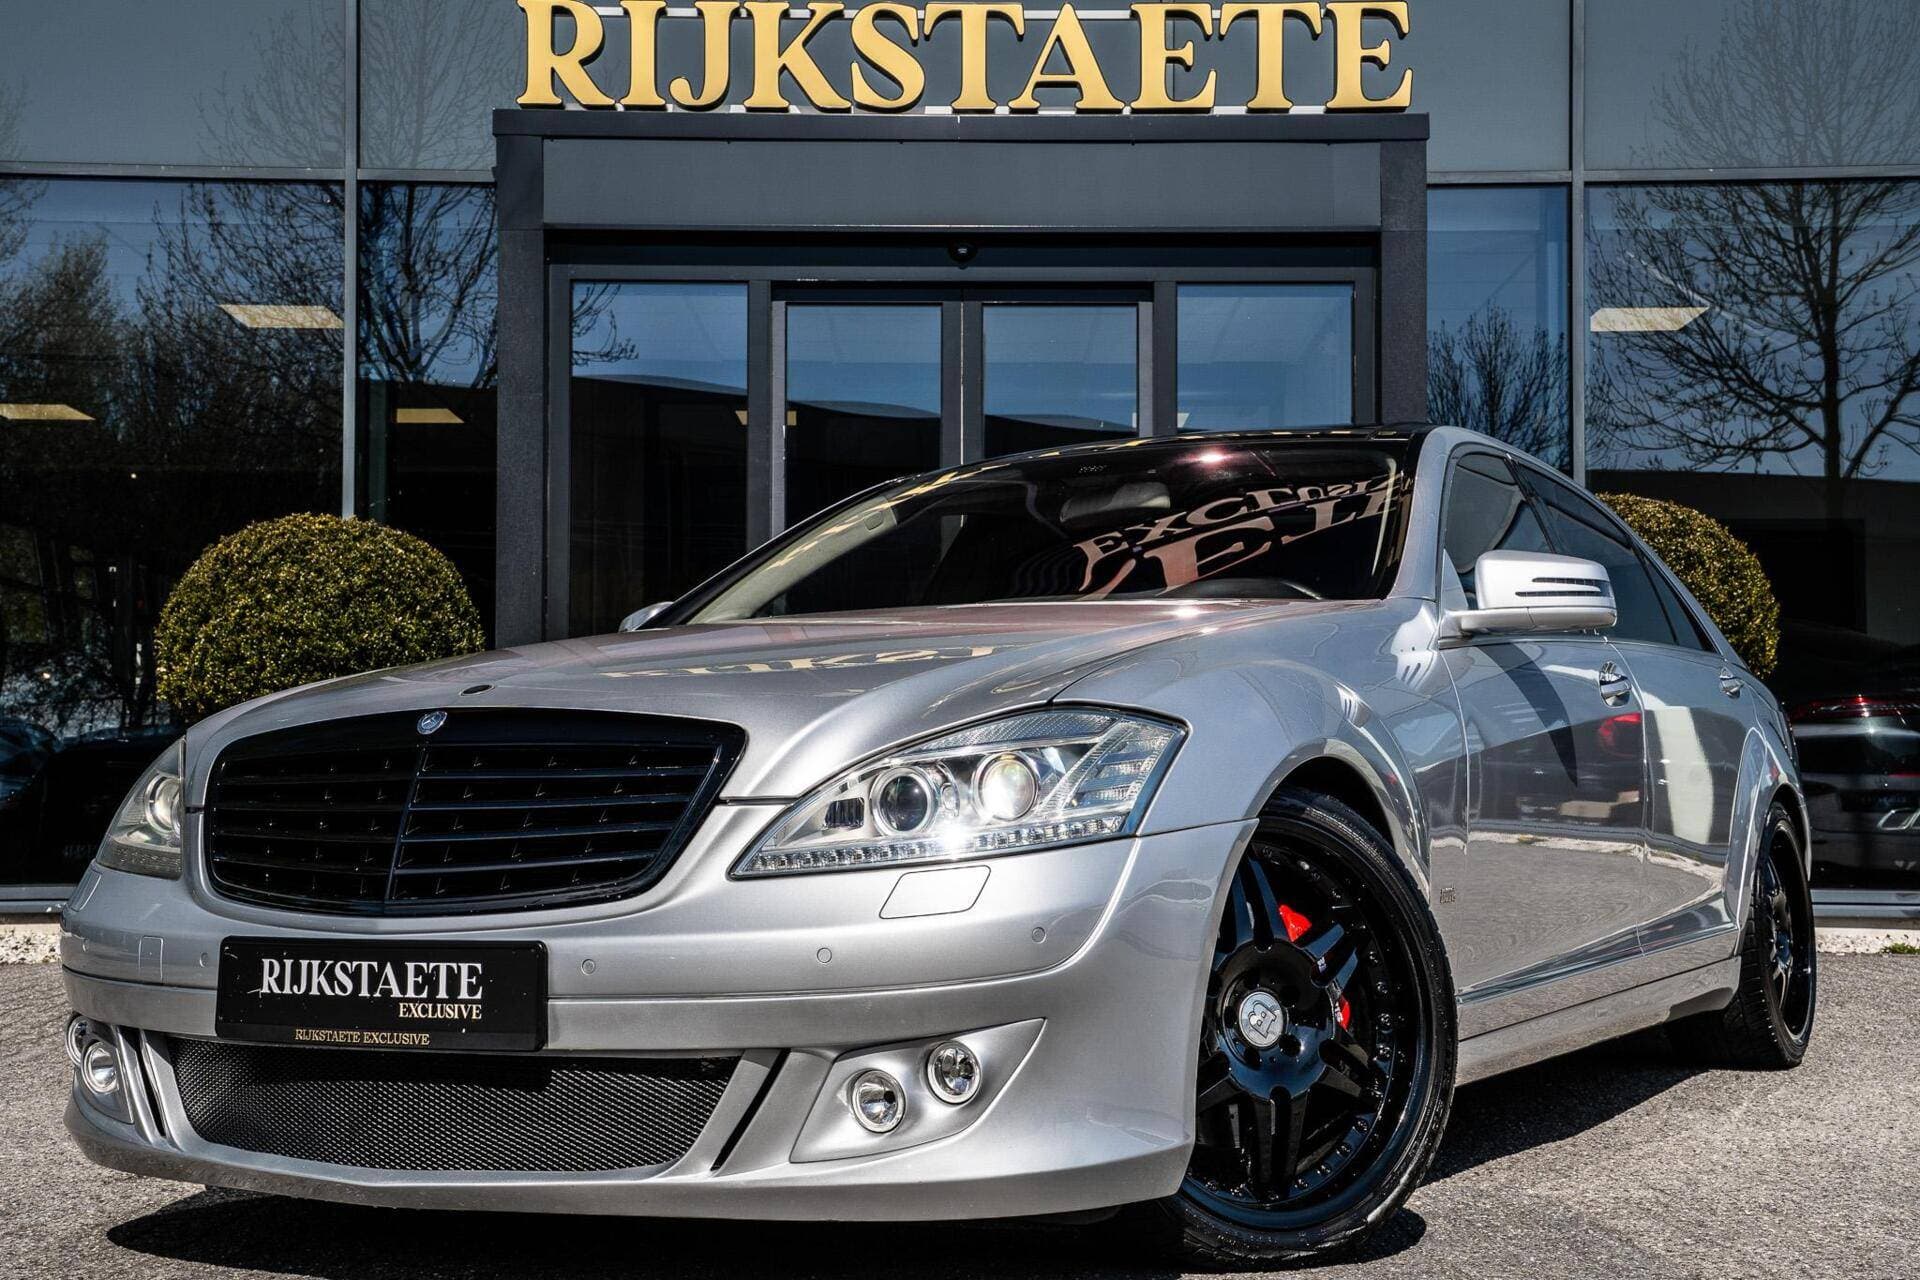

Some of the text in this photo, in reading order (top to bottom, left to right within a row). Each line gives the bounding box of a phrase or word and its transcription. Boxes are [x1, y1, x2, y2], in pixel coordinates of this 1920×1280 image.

[515, 0, 1414, 114] RIJKSTAETE
[260, 958, 483, 1000] RIJKSTAETE
[398, 1002, 482, 1020] EXCLUSIVE
[294, 1028, 430, 1046] RIJKSTAETE EXCLUSIVE
